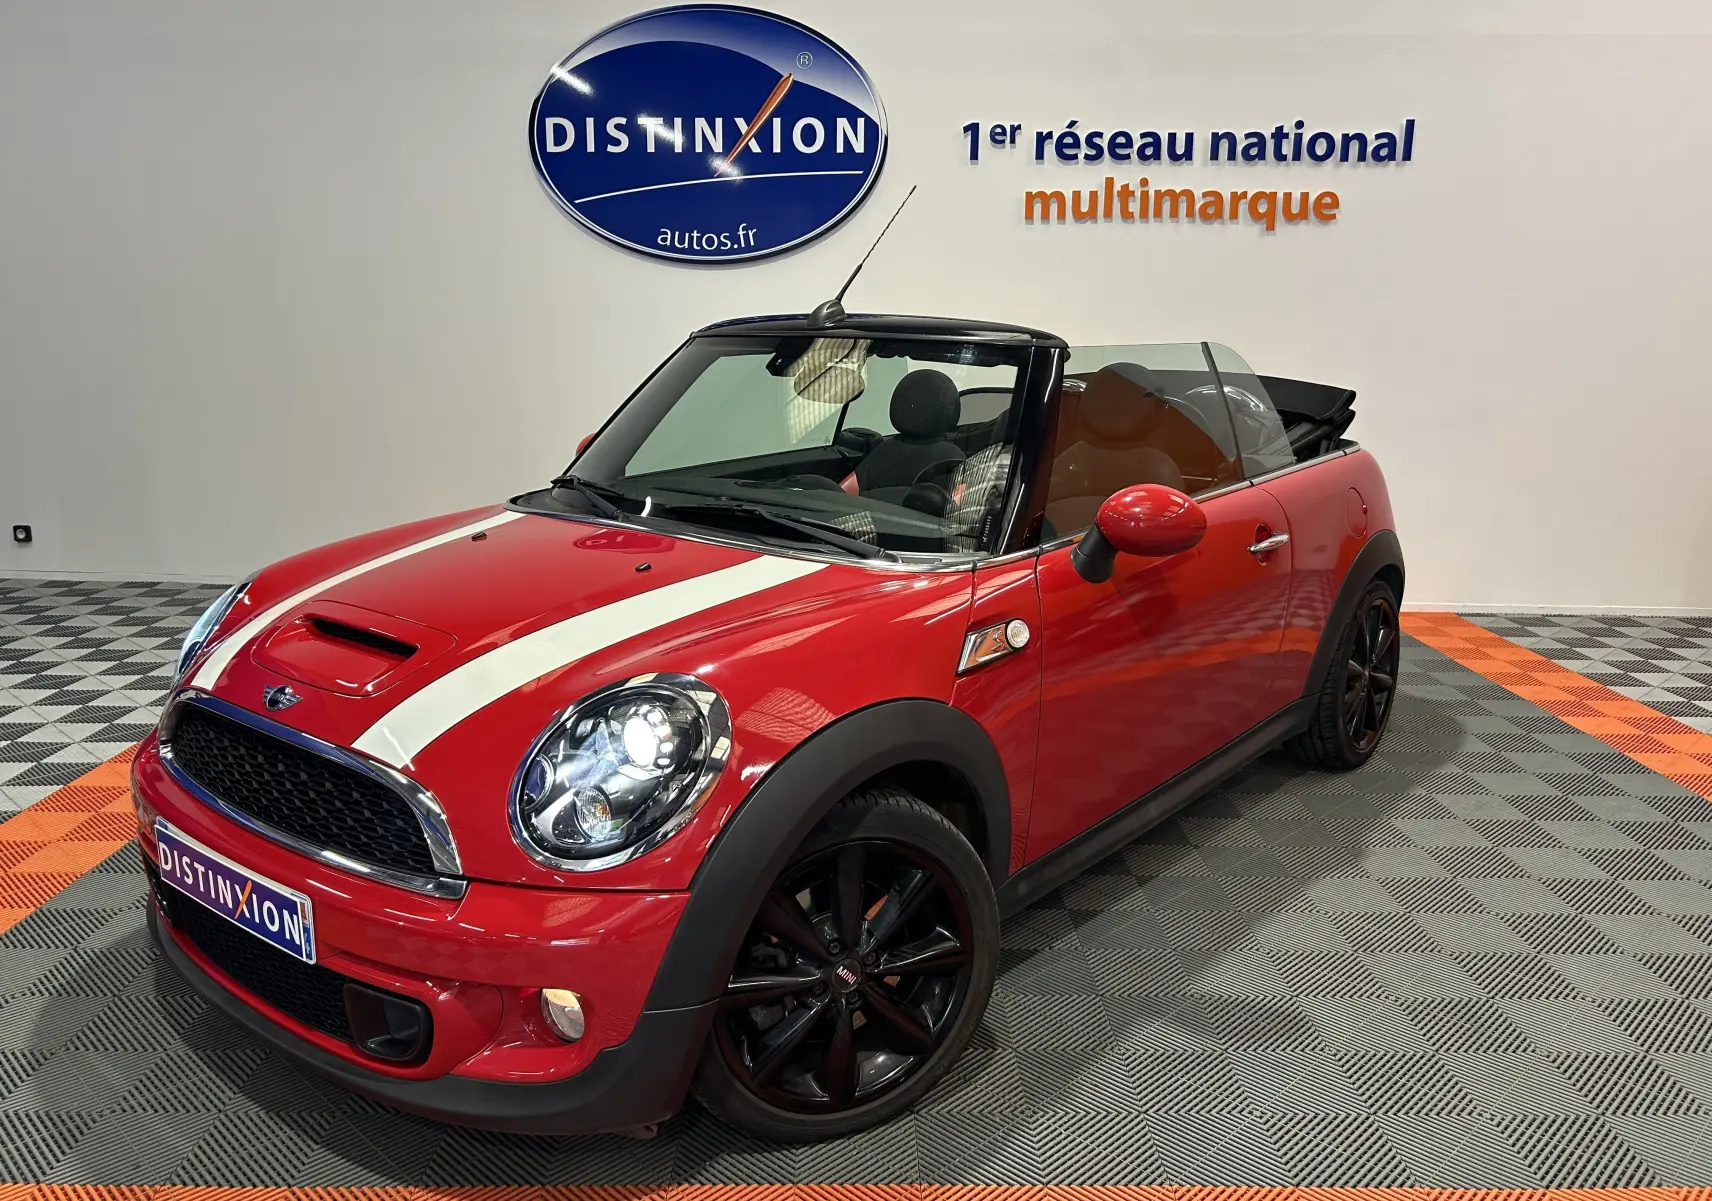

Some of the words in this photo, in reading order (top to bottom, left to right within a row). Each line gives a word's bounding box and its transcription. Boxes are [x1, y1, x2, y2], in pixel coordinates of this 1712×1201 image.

[545, 115, 866, 154] DISTINXION
[962, 121, 1022, 161] 1er
[1034, 119, 1195, 162] réseau
[1208, 118, 1416, 162] national
[1024, 176, 1341, 232] multimarque
[656, 223, 757, 250] autos.fr
[158, 841, 301, 946] DISTINXION
[836, 965, 857, 985] MINI
